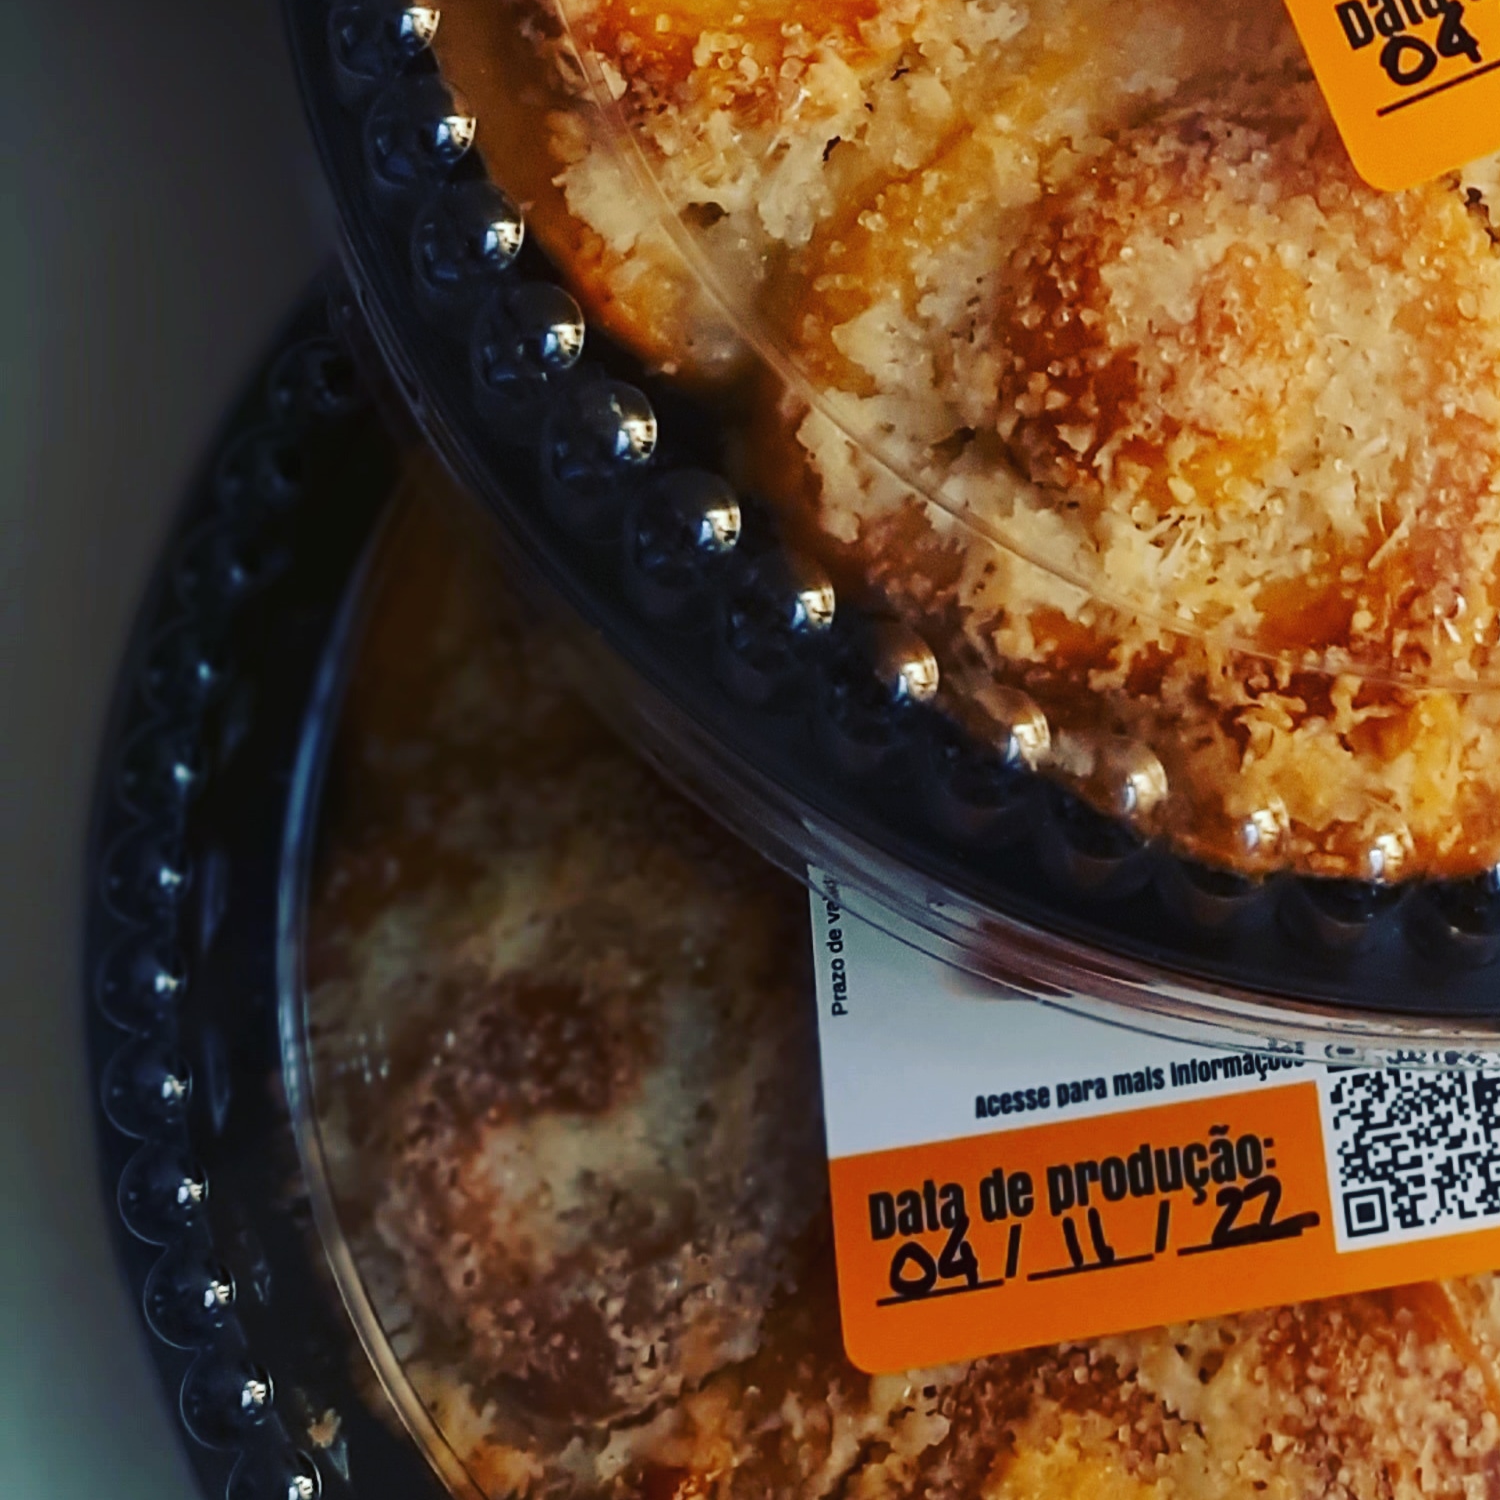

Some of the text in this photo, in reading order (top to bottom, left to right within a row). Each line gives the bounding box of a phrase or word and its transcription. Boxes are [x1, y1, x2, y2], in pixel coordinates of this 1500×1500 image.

[1379, 0, 1483, 87] 04
[826, 928, 844, 953] de
[831, 958, 849, 1017] Prazo
[975, 1085, 1051, 1119] Acesse
[1056, 1075, 1108, 1108] para
[1112, 1066, 1166, 1098] mais
[868, 1125, 1277, 1241] Data de produção:
[889, 1214, 979, 1297] 04
[1210, 1174, 1321, 1248] 22
